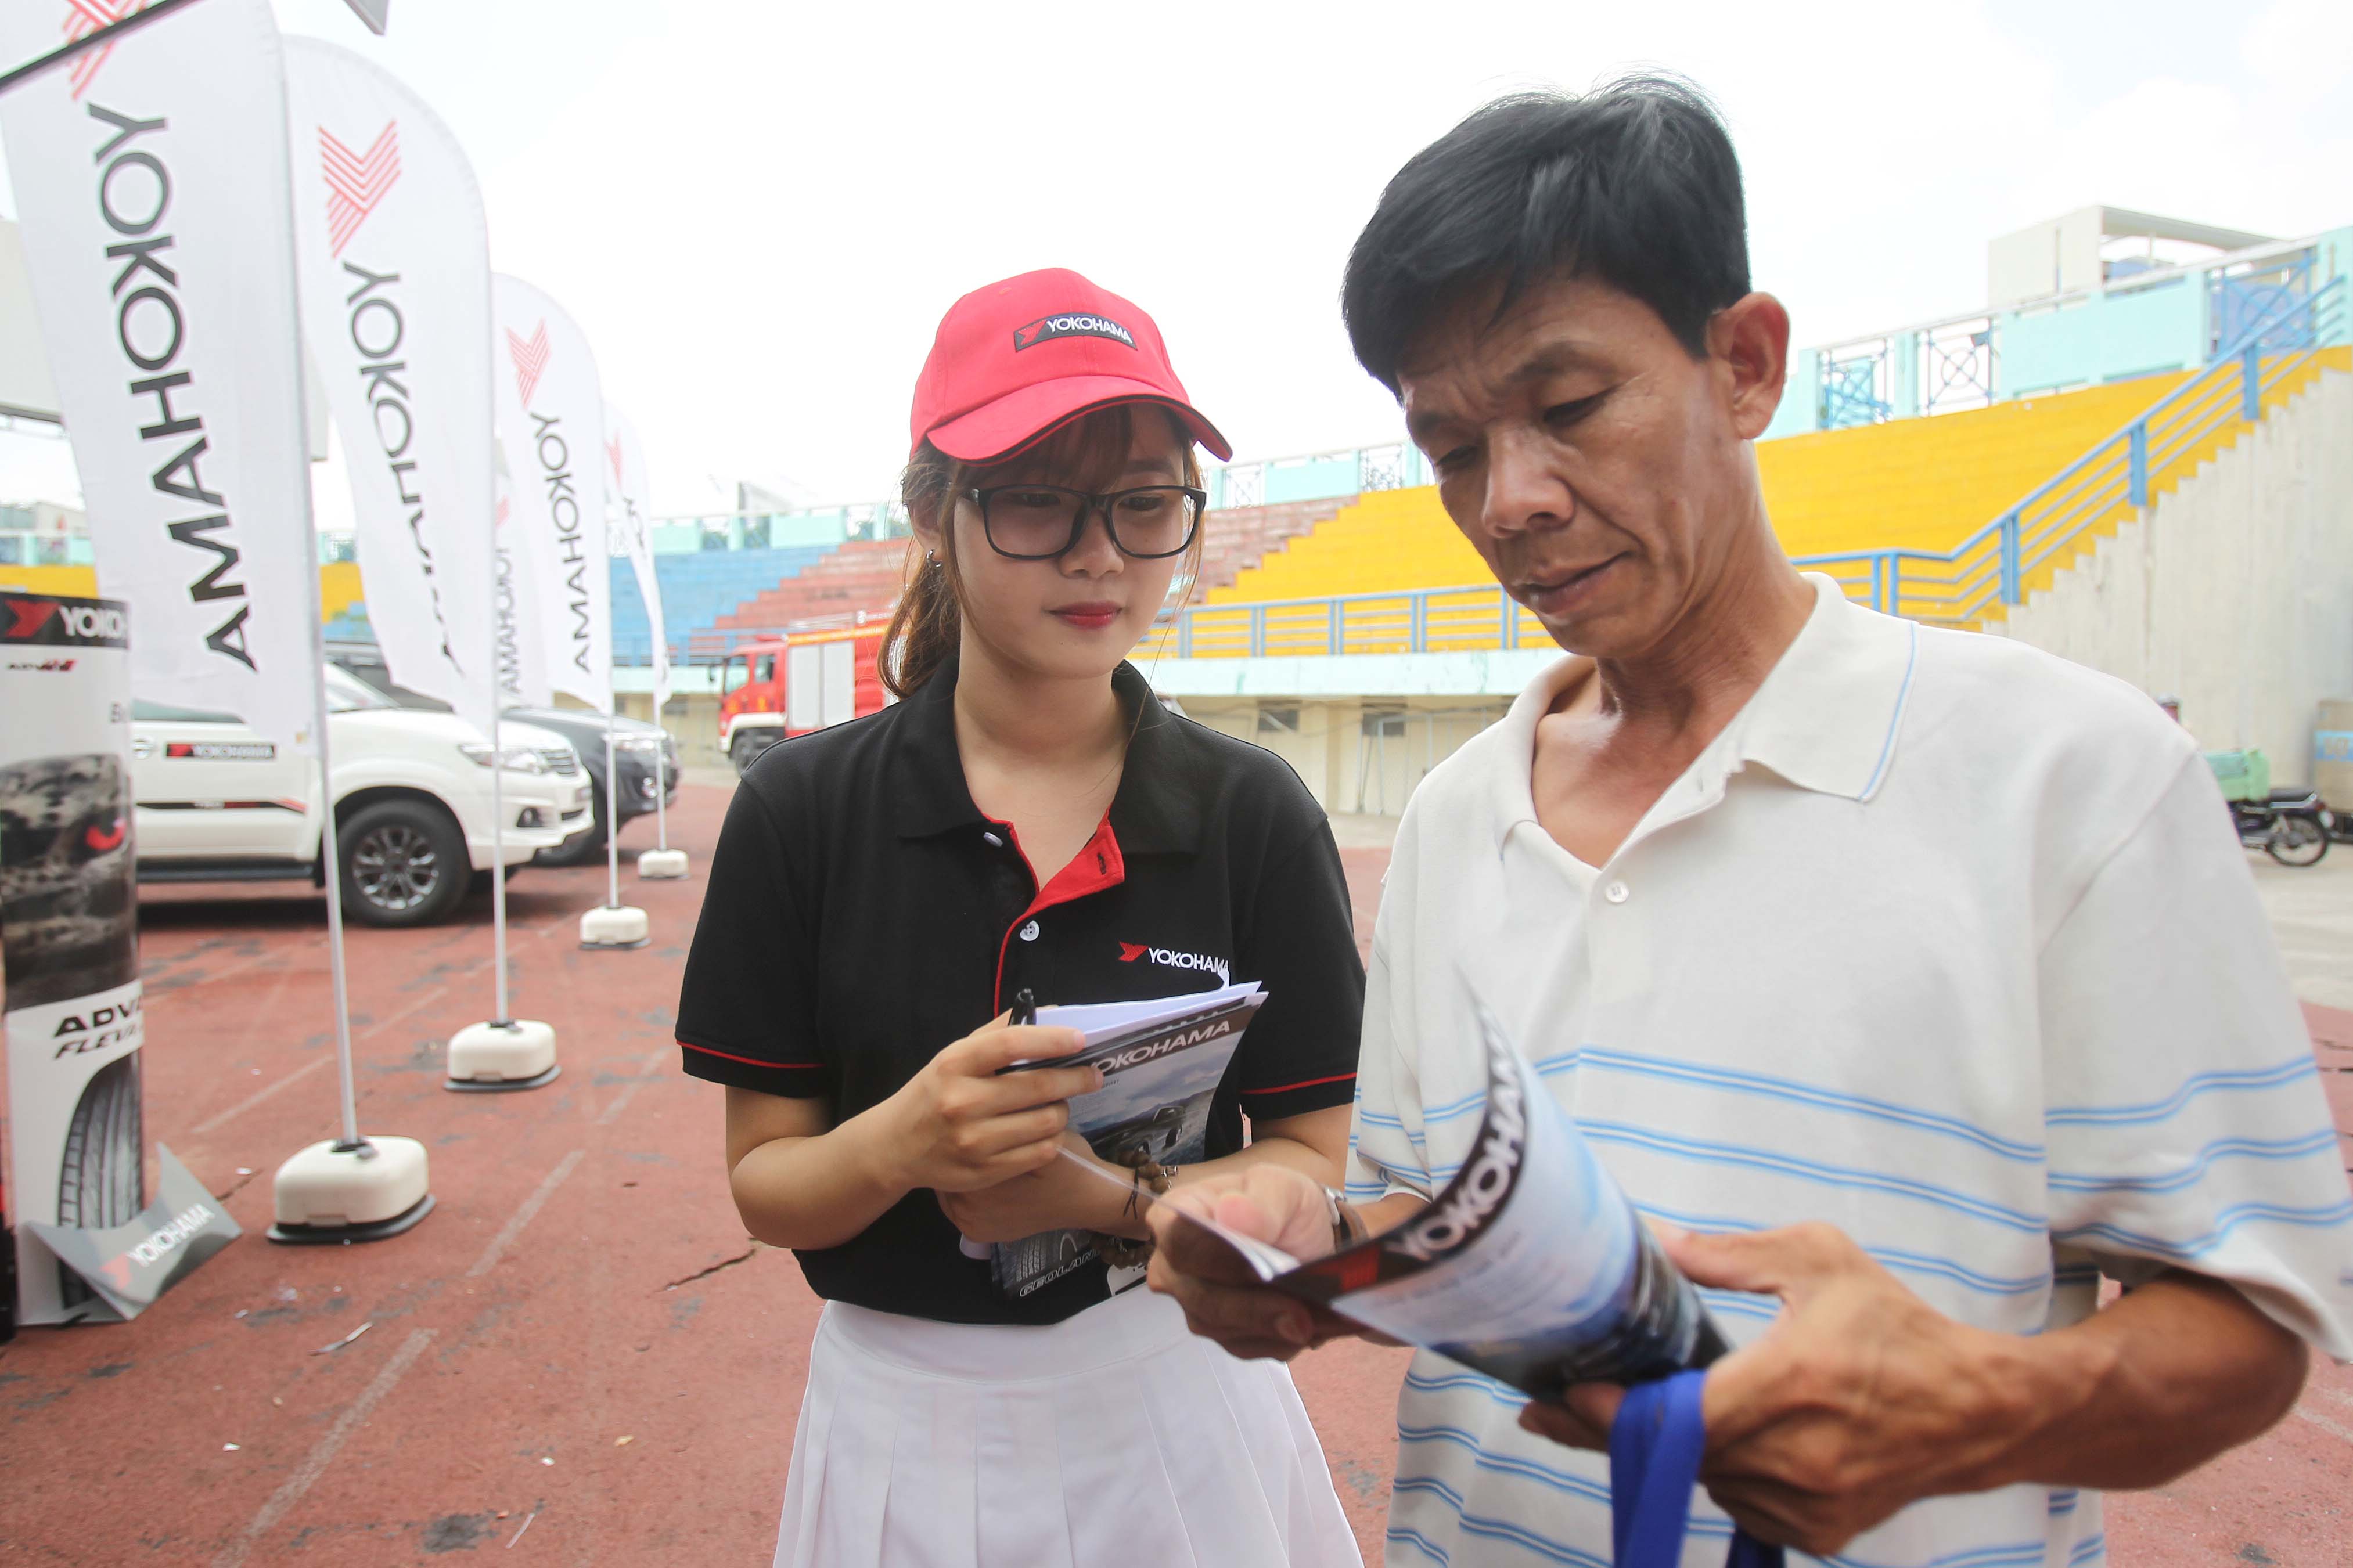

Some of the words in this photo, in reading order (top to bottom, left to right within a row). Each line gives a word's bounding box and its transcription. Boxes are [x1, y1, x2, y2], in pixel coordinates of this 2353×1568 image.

[1047, 316, 1133, 344] YOKOHAMA
[1091, 1020, 1231, 1073] OKOHAMA
[127, 1203, 215, 1267] YOKOHAMA
